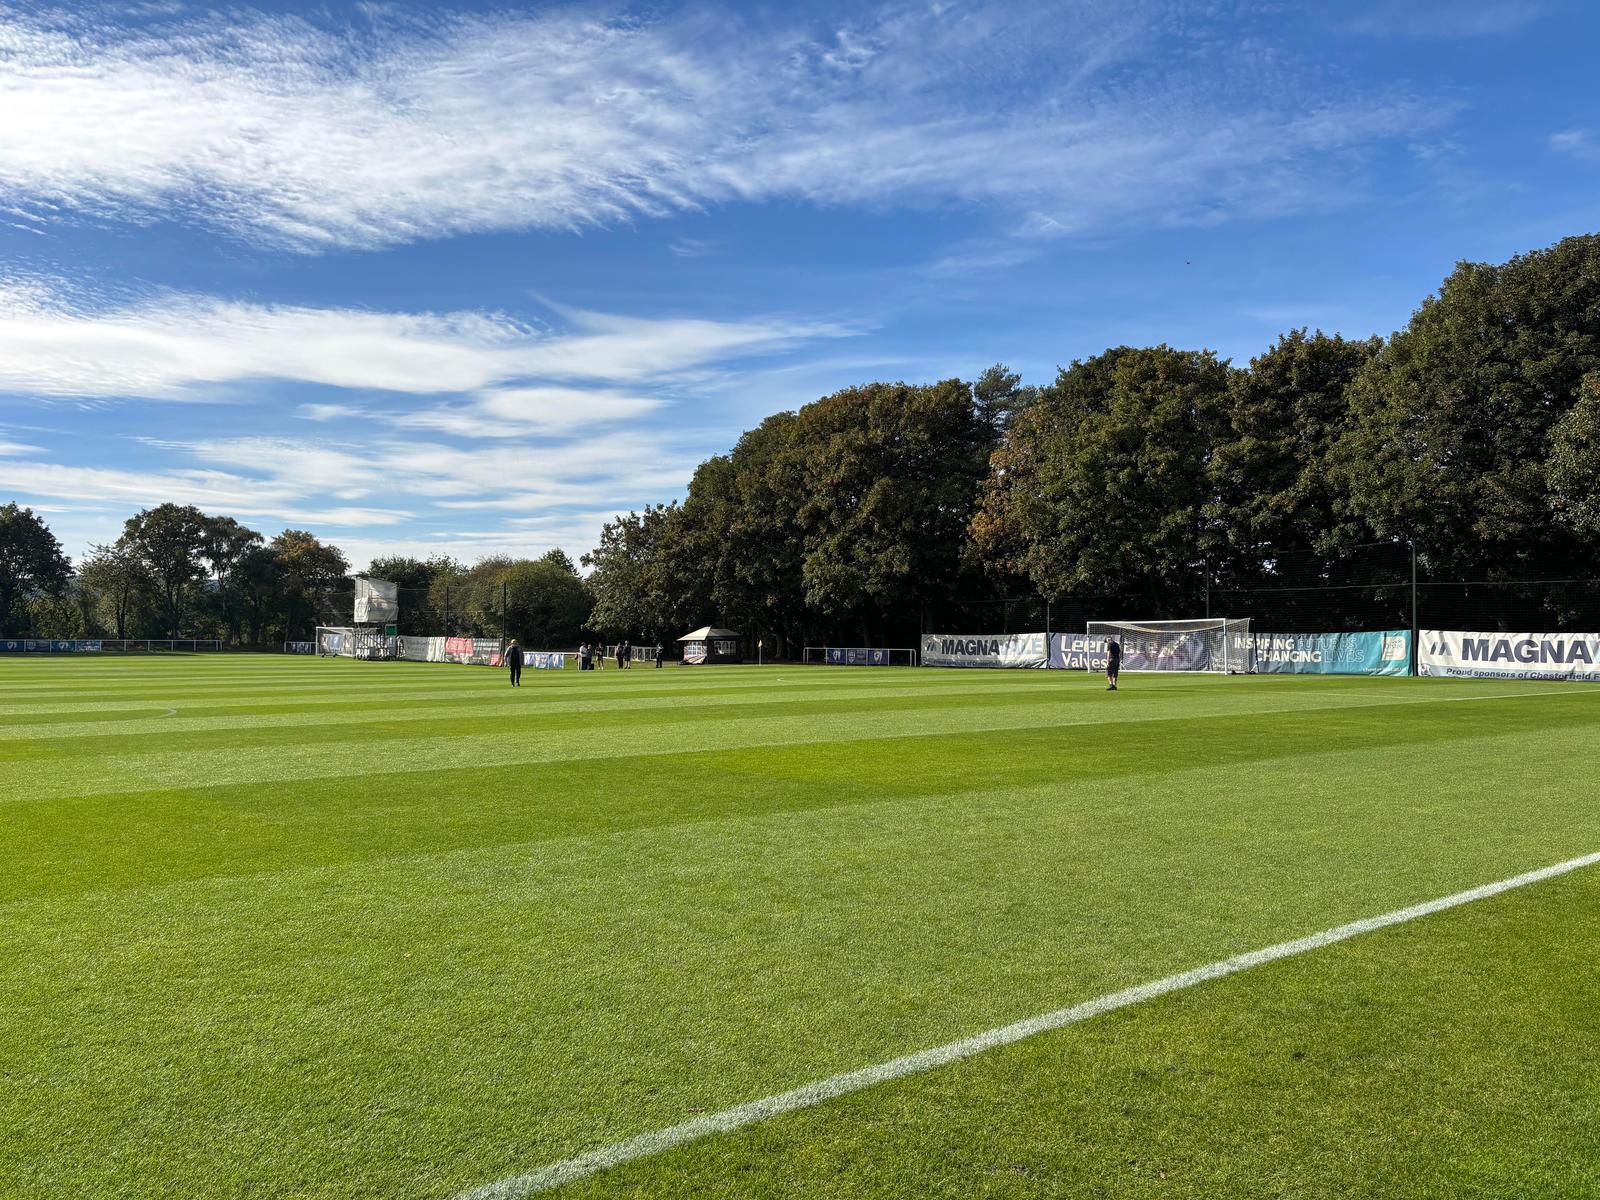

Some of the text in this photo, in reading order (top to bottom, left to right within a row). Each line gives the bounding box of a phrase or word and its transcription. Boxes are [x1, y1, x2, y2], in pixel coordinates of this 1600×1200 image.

[1061, 653, 1108, 669] Valves
[1256, 650, 1322, 662] CHANGING
[1446, 668, 1472, 676] Proud
[1474, 669, 1516, 678] sponsors
[1518, 671, 1529, 679] of
[1530, 672, 1591, 680] Chesterfield
